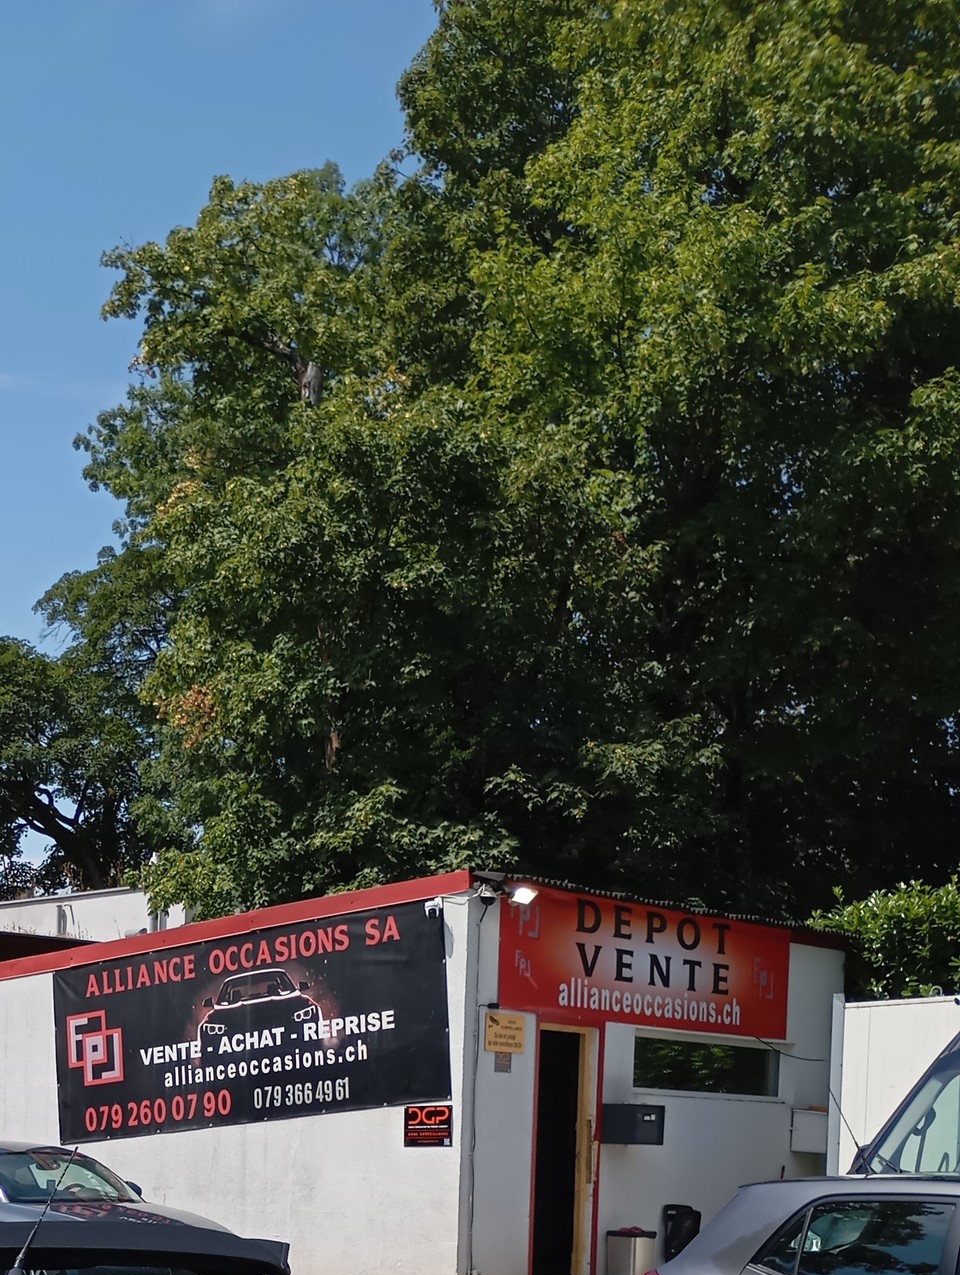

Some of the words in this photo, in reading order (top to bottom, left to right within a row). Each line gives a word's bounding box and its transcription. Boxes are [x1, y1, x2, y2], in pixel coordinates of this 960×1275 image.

[575, 898, 732, 955] DEPOT
[85, 954, 196, 998] ALLIANCE
[208, 925, 350, 974] OCCASIONS
[364, 915, 401, 946] SA
[576, 942, 730, 996] VENTE
[558, 977, 740, 1026] allianceoccasions.ch
[140, 1040, 202, 1066] VENTE
[218, 1027, 285, 1055] ACHAT
[303, 1010, 396, 1042] REPRISE
[164, 1039, 368, 1088] allianceoccasions.ch
[85, 1103, 124, 1132] 079
[127, 1098, 167, 1126] 260
[171, 1093, 198, 1121] 07
[203, 1088, 232, 1118] 90
[253, 1085, 282, 1109] 079
[285, 1082, 313, 1106] 366
[315, 1079, 333, 1103] 49
[335, 1076, 350, 1101] 61
[408, 1106, 449, 1124] DGP
